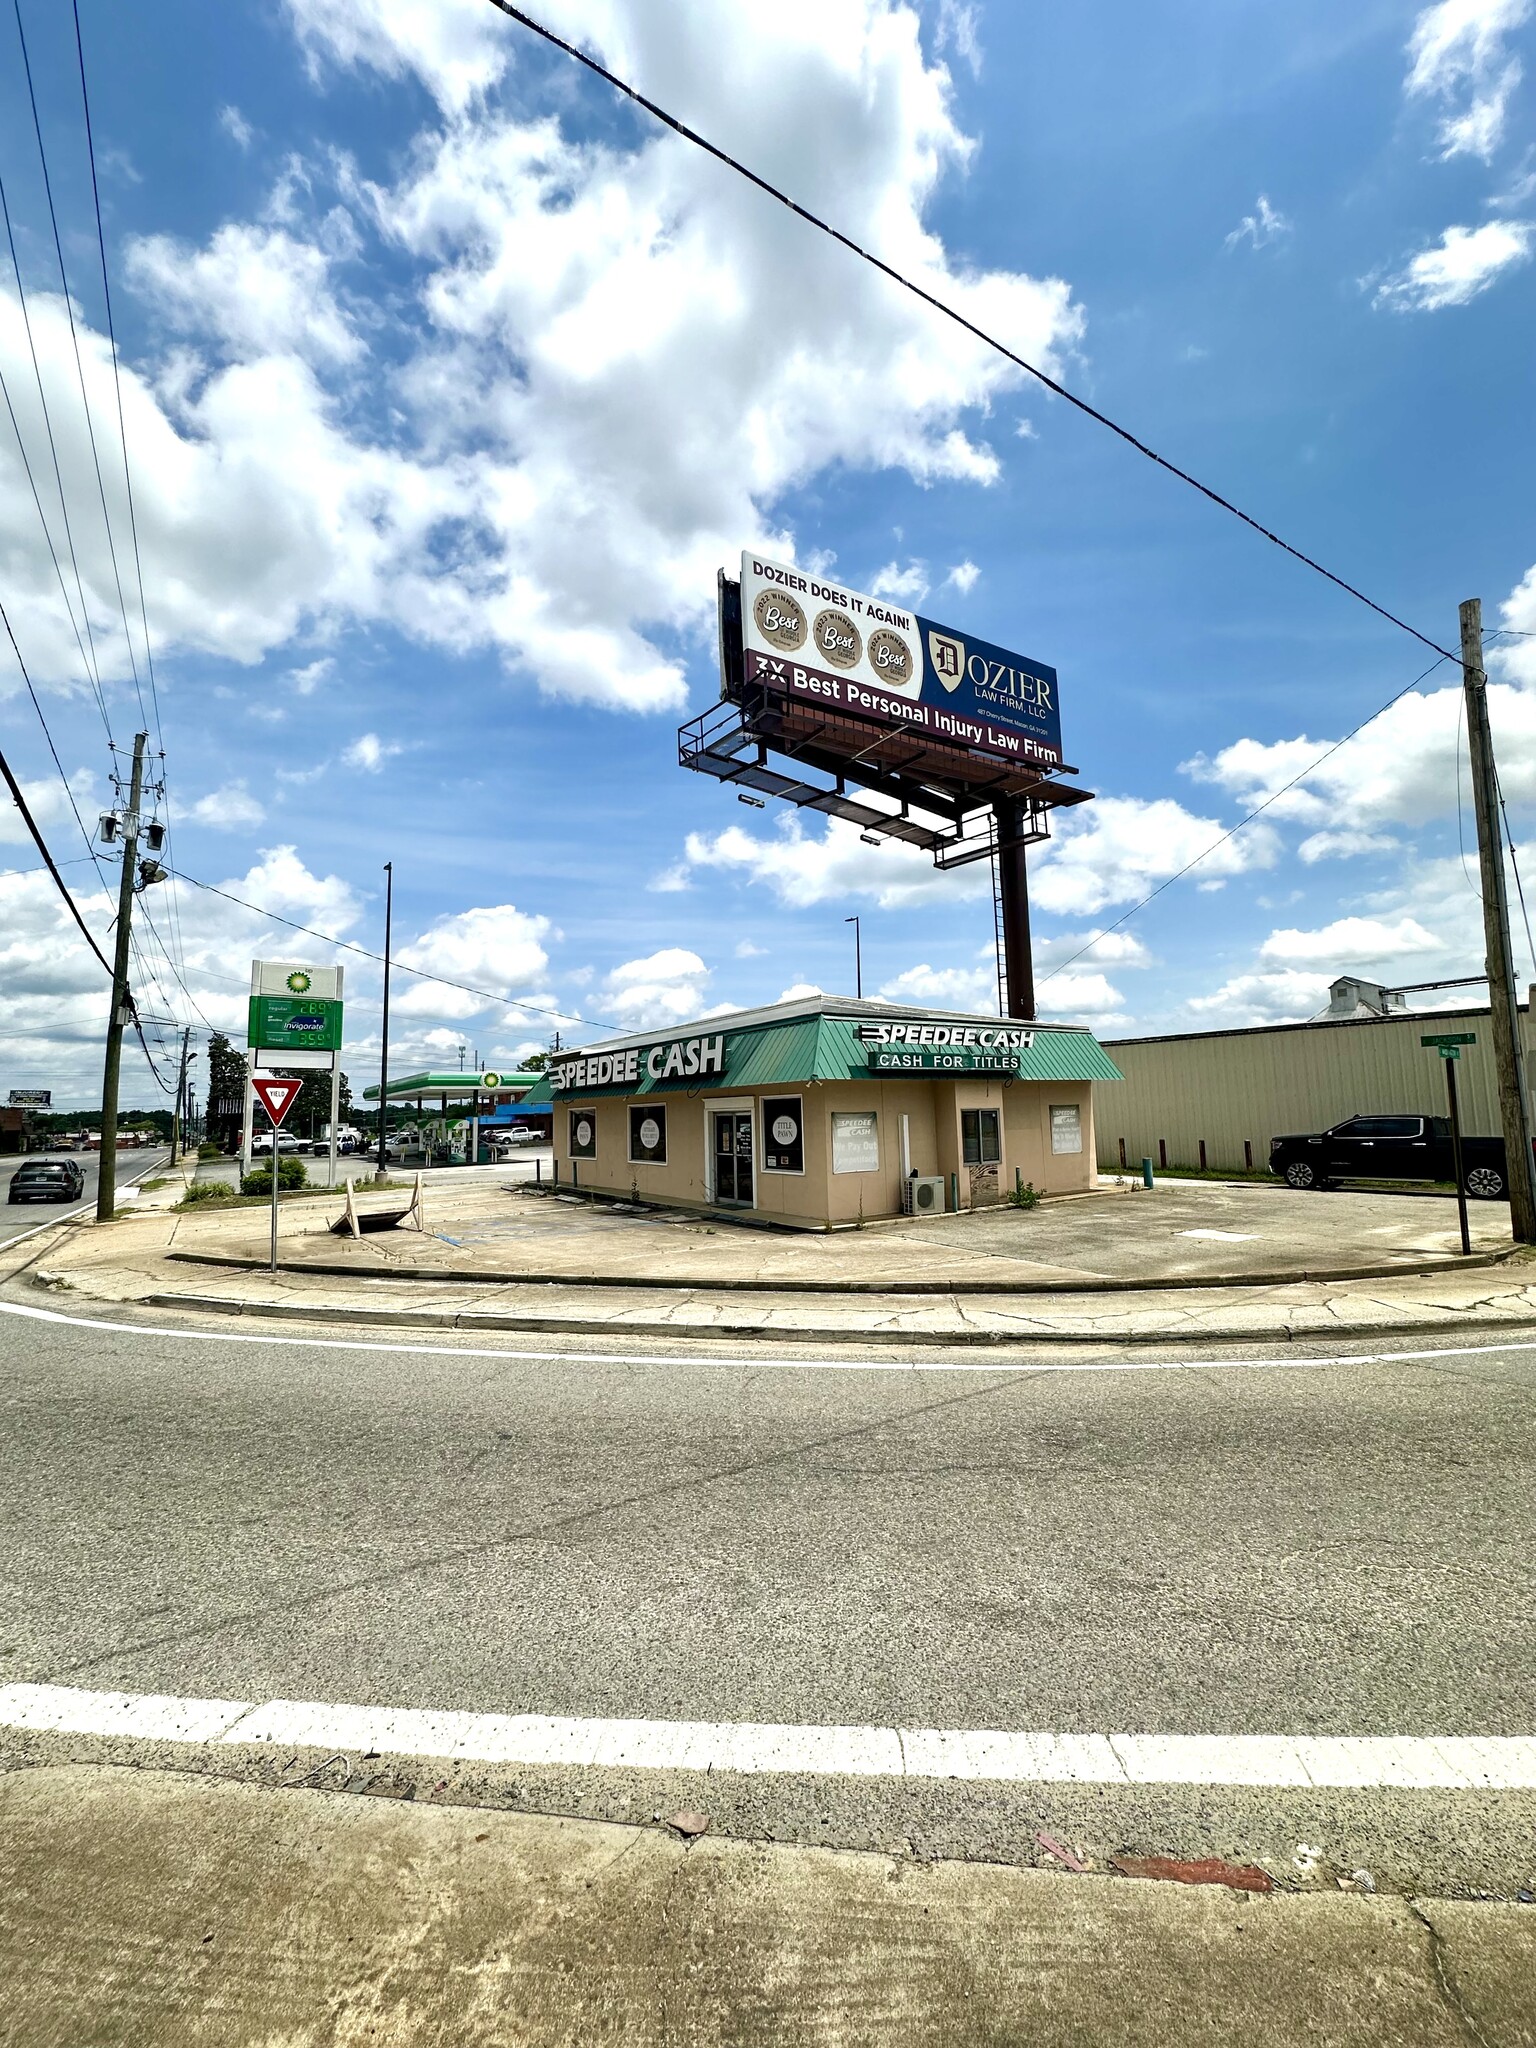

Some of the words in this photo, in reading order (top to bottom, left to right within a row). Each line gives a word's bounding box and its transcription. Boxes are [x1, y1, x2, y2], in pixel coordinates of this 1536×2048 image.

[753, 560, 807, 593] DOZIER
[811, 582, 848, 608] DOES
[851, 597, 863, 613] IT
[866, 604, 910, 631] AGAIN!
[757, 595, 770, 613] 2022
[771, 593, 800, 614] WINNER
[763, 606, 800, 631] Best
[816, 615, 828, 633] 2023
[829, 613, 855, 634] WINNER
[821, 626, 855, 650] Best
[870, 634, 881, 652] 2024
[882, 632, 906, 652] WINNER
[875, 644, 907, 667] Best
[755, 656, 787, 685] 3X
[792, 667, 841, 700] Best
[847, 684, 929, 726] Personal
[934, 710, 982, 744] Injury
[987, 726, 1019, 752] Law
[1023, 737, 1057, 763] Firm
[974, 685, 998, 703] LAW
[1000, 694, 1026, 715] FIRM,
[1028, 704, 1047, 720] LLC
[283, 1021, 324, 1031] Invigorate
[863, 1024, 977, 1045] SPEEDEE
[979, 1028, 1035, 1048] CASH
[550, 1049, 639, 1089] SPEEDEE
[647, 1035, 724, 1079] CASH
[879, 1053, 923, 1067] CASH
[933, 1055, 963, 1068] FOR
[973, 1056, 1019, 1069] TITLES
[777, 1121, 793, 1130] TITLE
[837, 1119, 872, 1127] SPEEDEE
[851, 1128, 871, 1136] CASH
[777, 1130, 793, 1138] PAWN
[863, 1140, 877, 1151] Out
